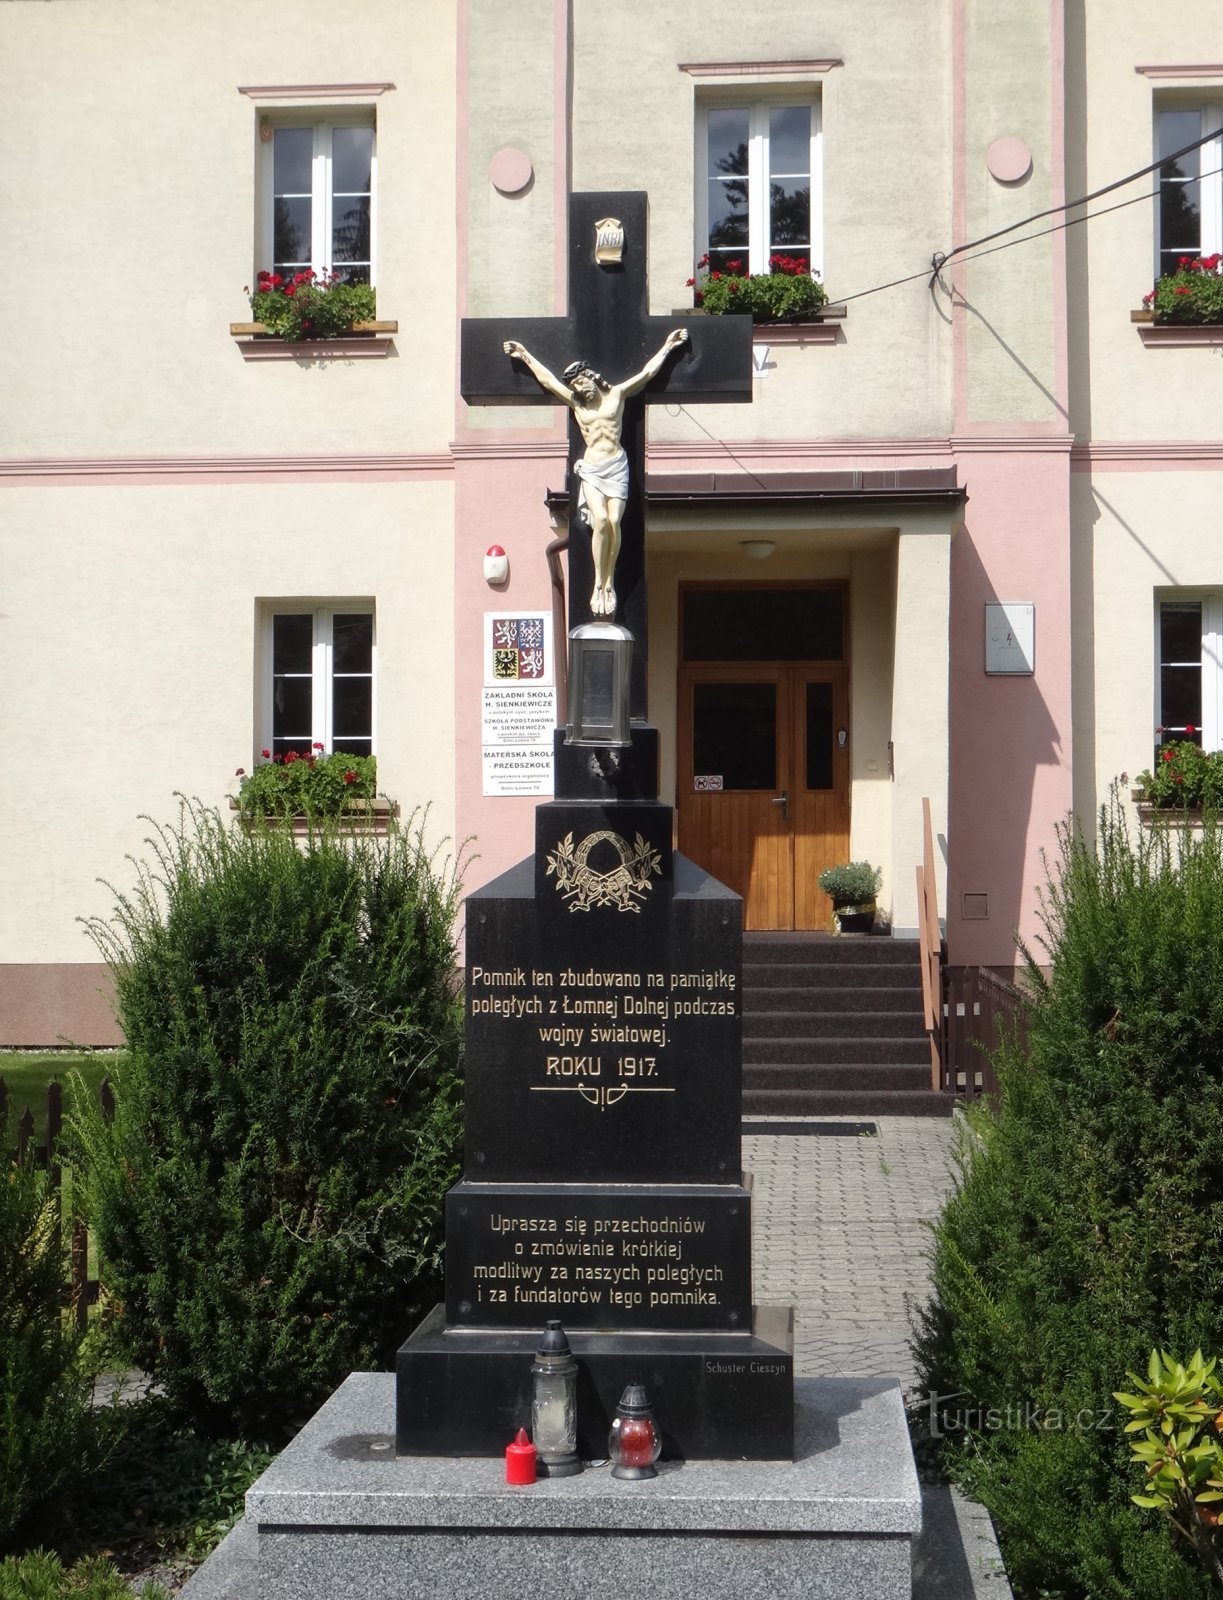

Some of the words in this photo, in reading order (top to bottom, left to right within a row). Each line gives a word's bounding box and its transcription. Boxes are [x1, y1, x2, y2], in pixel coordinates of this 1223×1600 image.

[495, 700, 553, 708] SIENKIEWICZE
[472, 967, 526, 986] Pomnik
[532, 969, 553, 986] ten
[560, 969, 641, 987] zbudowano
[647, 974, 664, 987] na
[670, 969, 736, 991] pamiątkę
[472, 995, 543, 1018] poległych
[550, 1000, 557, 1013] z
[563, 996, 618, 1018] Łomnej
[624, 996, 668, 1019] Dolnej
[674, 997, 735, 1018] podczas
[539, 1024, 584, 1046] wojny
[591, 1023, 670, 1047] światowej.
[546, 1057, 601, 1076] ROKU
[618, 1057, 658, 1076] 1917.
[490, 1214, 557, 1234] Uprasza
[565, 1215, 586, 1235] się
[594, 1215, 705, 1236] przechodniów
[515, 1243, 523, 1255] o
[532, 1239, 614, 1256] zmówienie
[622, 1240, 682, 1260] krótkiej
[473, 1262, 543, 1283] modlitwy
[551, 1266, 567, 1280] za
[576, 1263, 640, 1284] naszych
[647, 1265, 723, 1284] poległych
[477, 1285, 481, 1302] i
[489, 1289, 507, 1302] za
[515, 1286, 601, 1303] fundatorów
[610, 1289, 641, 1308] tego
[651, 1287, 721, 1308] pomnika.
[706, 1362, 745, 1373] Schuster
[751, 1362, 786, 1375] Cieszyn
